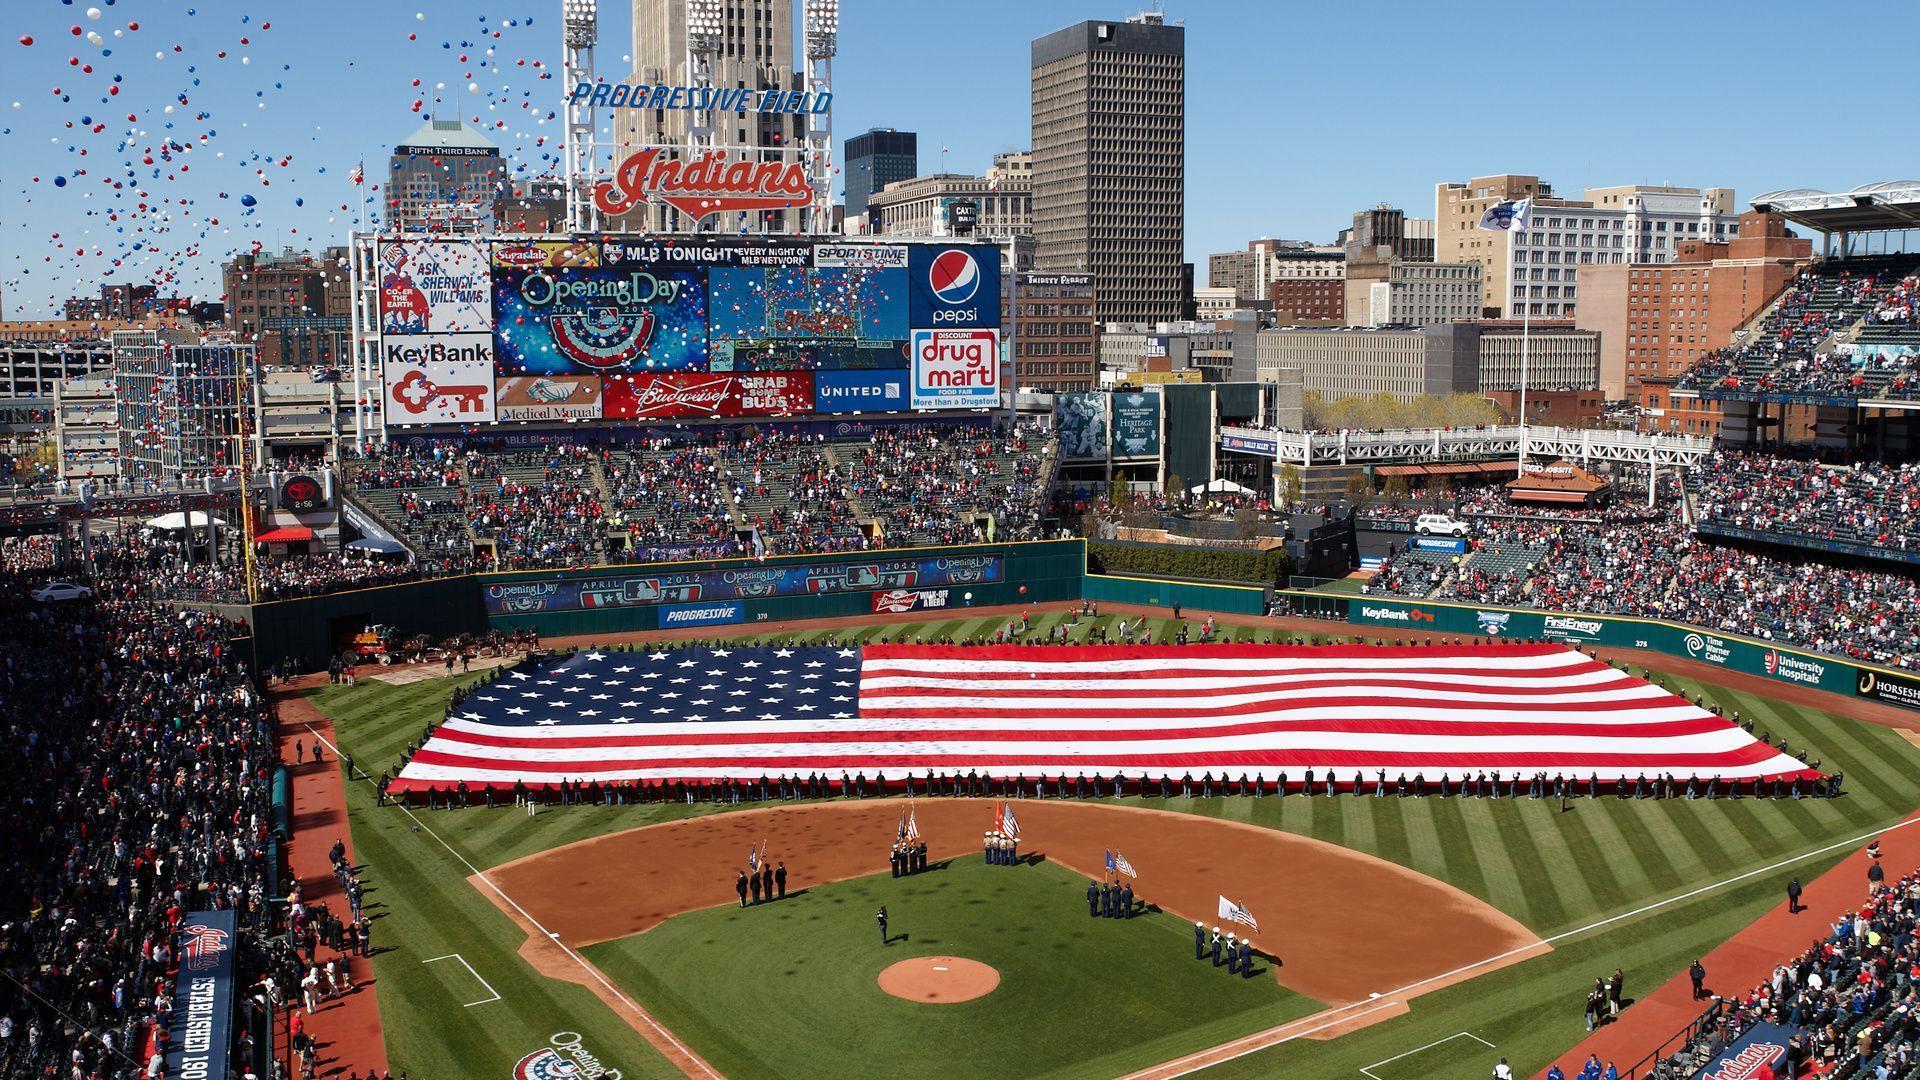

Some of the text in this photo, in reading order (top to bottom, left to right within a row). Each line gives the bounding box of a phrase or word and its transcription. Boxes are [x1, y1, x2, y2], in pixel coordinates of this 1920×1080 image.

[570, 83, 834, 114] PROGRESSIVE FIELD
[435, 147, 463, 155] THIRD
[593, 148, 813, 217] Indians
[627, 247, 733, 261] MLB TONIGHT
[738, 248, 809, 256] EVERY NIGHT ON
[761, 256, 805, 264] NETWORK
[417, 262, 440, 276] ASK
[422, 276, 477, 289] SHERWN-
[521, 272, 682, 306] Opening Day
[933, 307, 977, 324] pepsi
[387, 344, 490, 367] KeyBank
[922, 332, 982, 368] drug
[741, 376, 788, 388] GRAB
[928, 366, 991, 387] mart
[633, 387, 731, 405] Budweiser
[821, 386, 882, 397] UNITED
[742, 396, 788, 409] BUDS
[934, 398, 952, 406] than
[961, 397, 998, 407] Drugstore
[503, 405, 597, 420] Medical Mutual
[1120, 418, 1153, 427] HERITAGE
[295, 500, 313, 508] 2:56
[1371, 521, 1410, 531] 2:56 PM
[807, 561, 916, 576] APRIL 2012
[937, 555, 995, 571] Opening Day
[582, 575, 701, 590] APRIL 2012
[723, 568, 787, 584] Opening Day
[489, 582, 558, 600] Opening Day
[667, 607, 738, 622] PROGRESSIVE
[1362, 607, 1409, 621] KeyBank
[1544, 616, 1603, 633] FirstEnergy
[1635, 640, 1648, 648] 375
[1706, 636, 1724, 647] Time
[1705, 643, 1731, 657] Warner
[1705, 652, 1726, 664] Cable
[1779, 655, 1825, 677] University
[1778, 665, 1820, 684] Hospitals
[184, 976, 216, 1053] ESTABLISHED
[180, 1055, 209, 1080] 190
